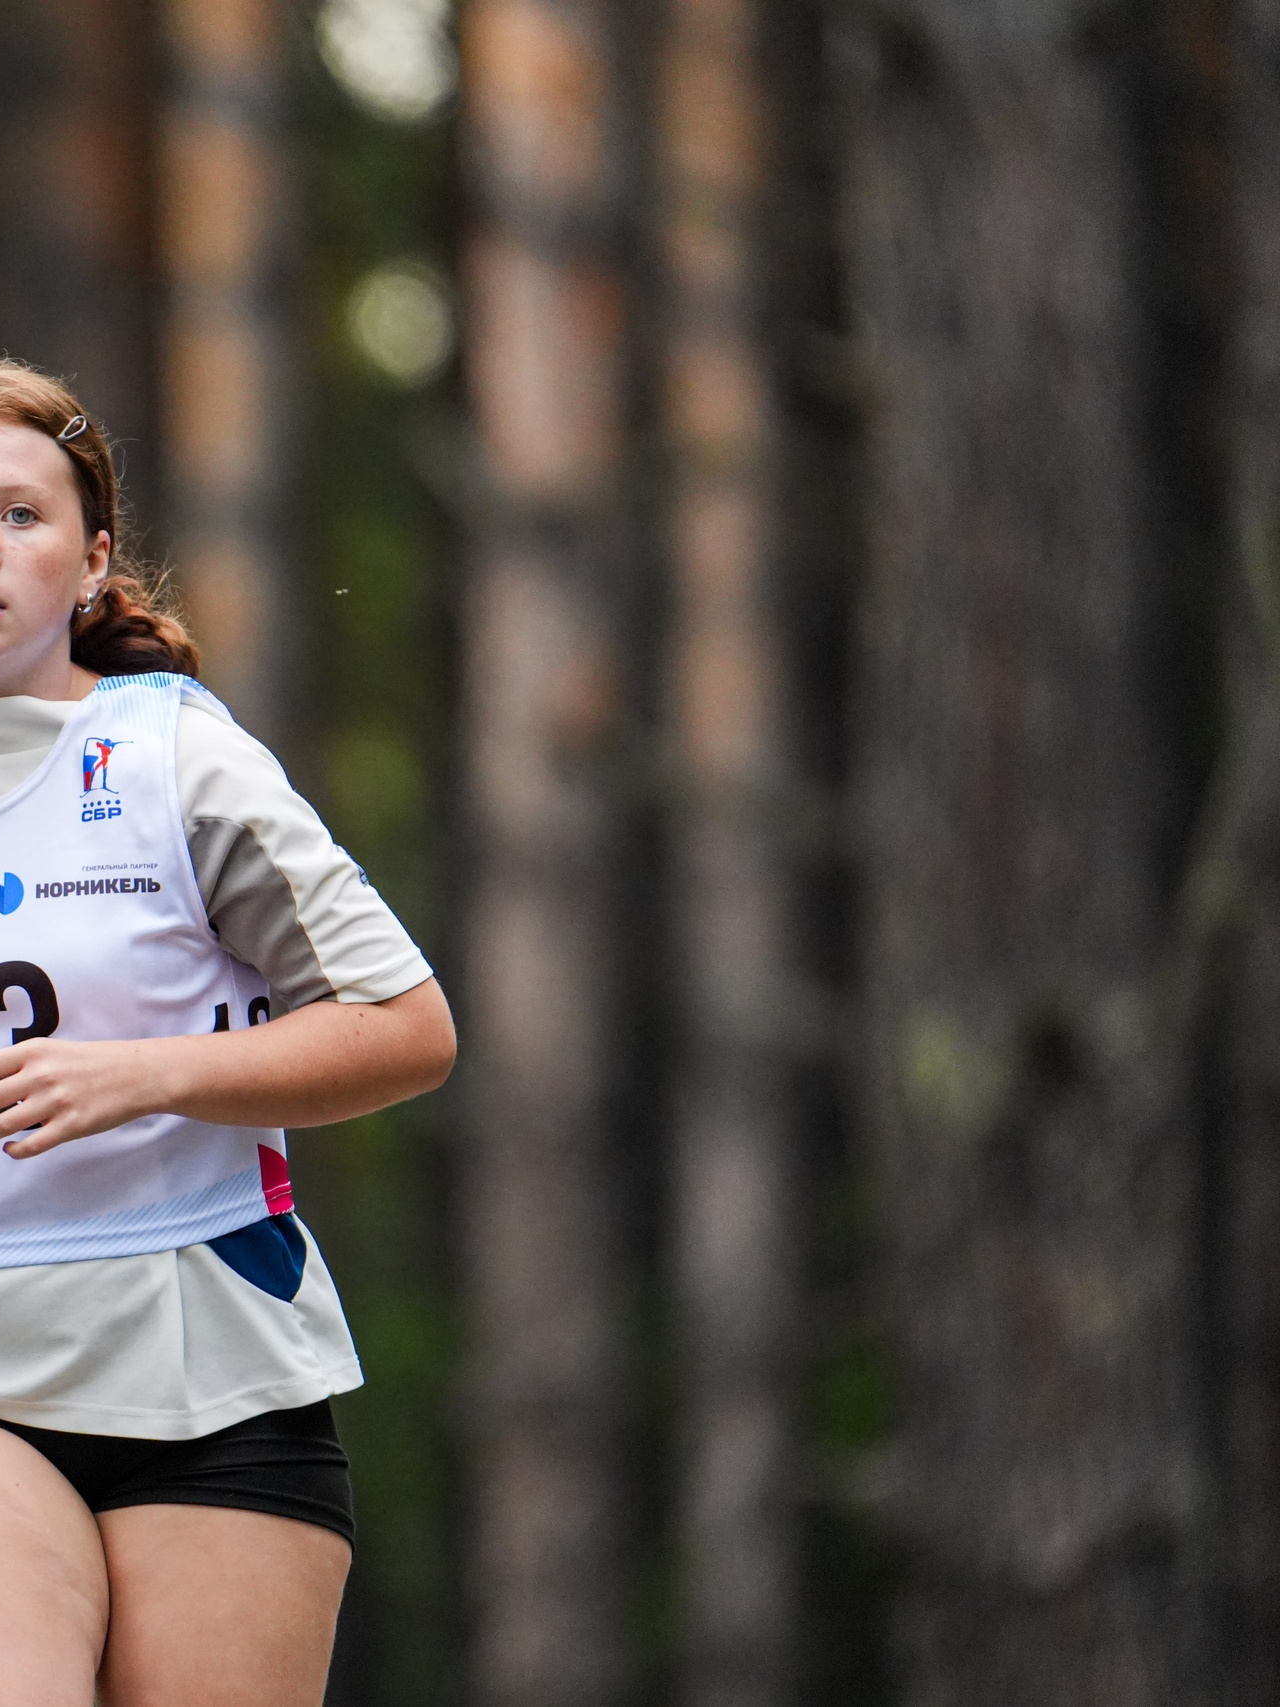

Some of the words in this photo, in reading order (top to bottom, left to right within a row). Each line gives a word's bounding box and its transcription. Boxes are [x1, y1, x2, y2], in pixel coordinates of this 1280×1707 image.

[81, 807, 122, 823] СБР
[82, 863, 128, 872] ГЕНЕРАЛЬНЫЙ
[130, 862, 159, 870] ПАРТНЕР
[35, 877, 161, 899] НОРНИКЕЛЬ
